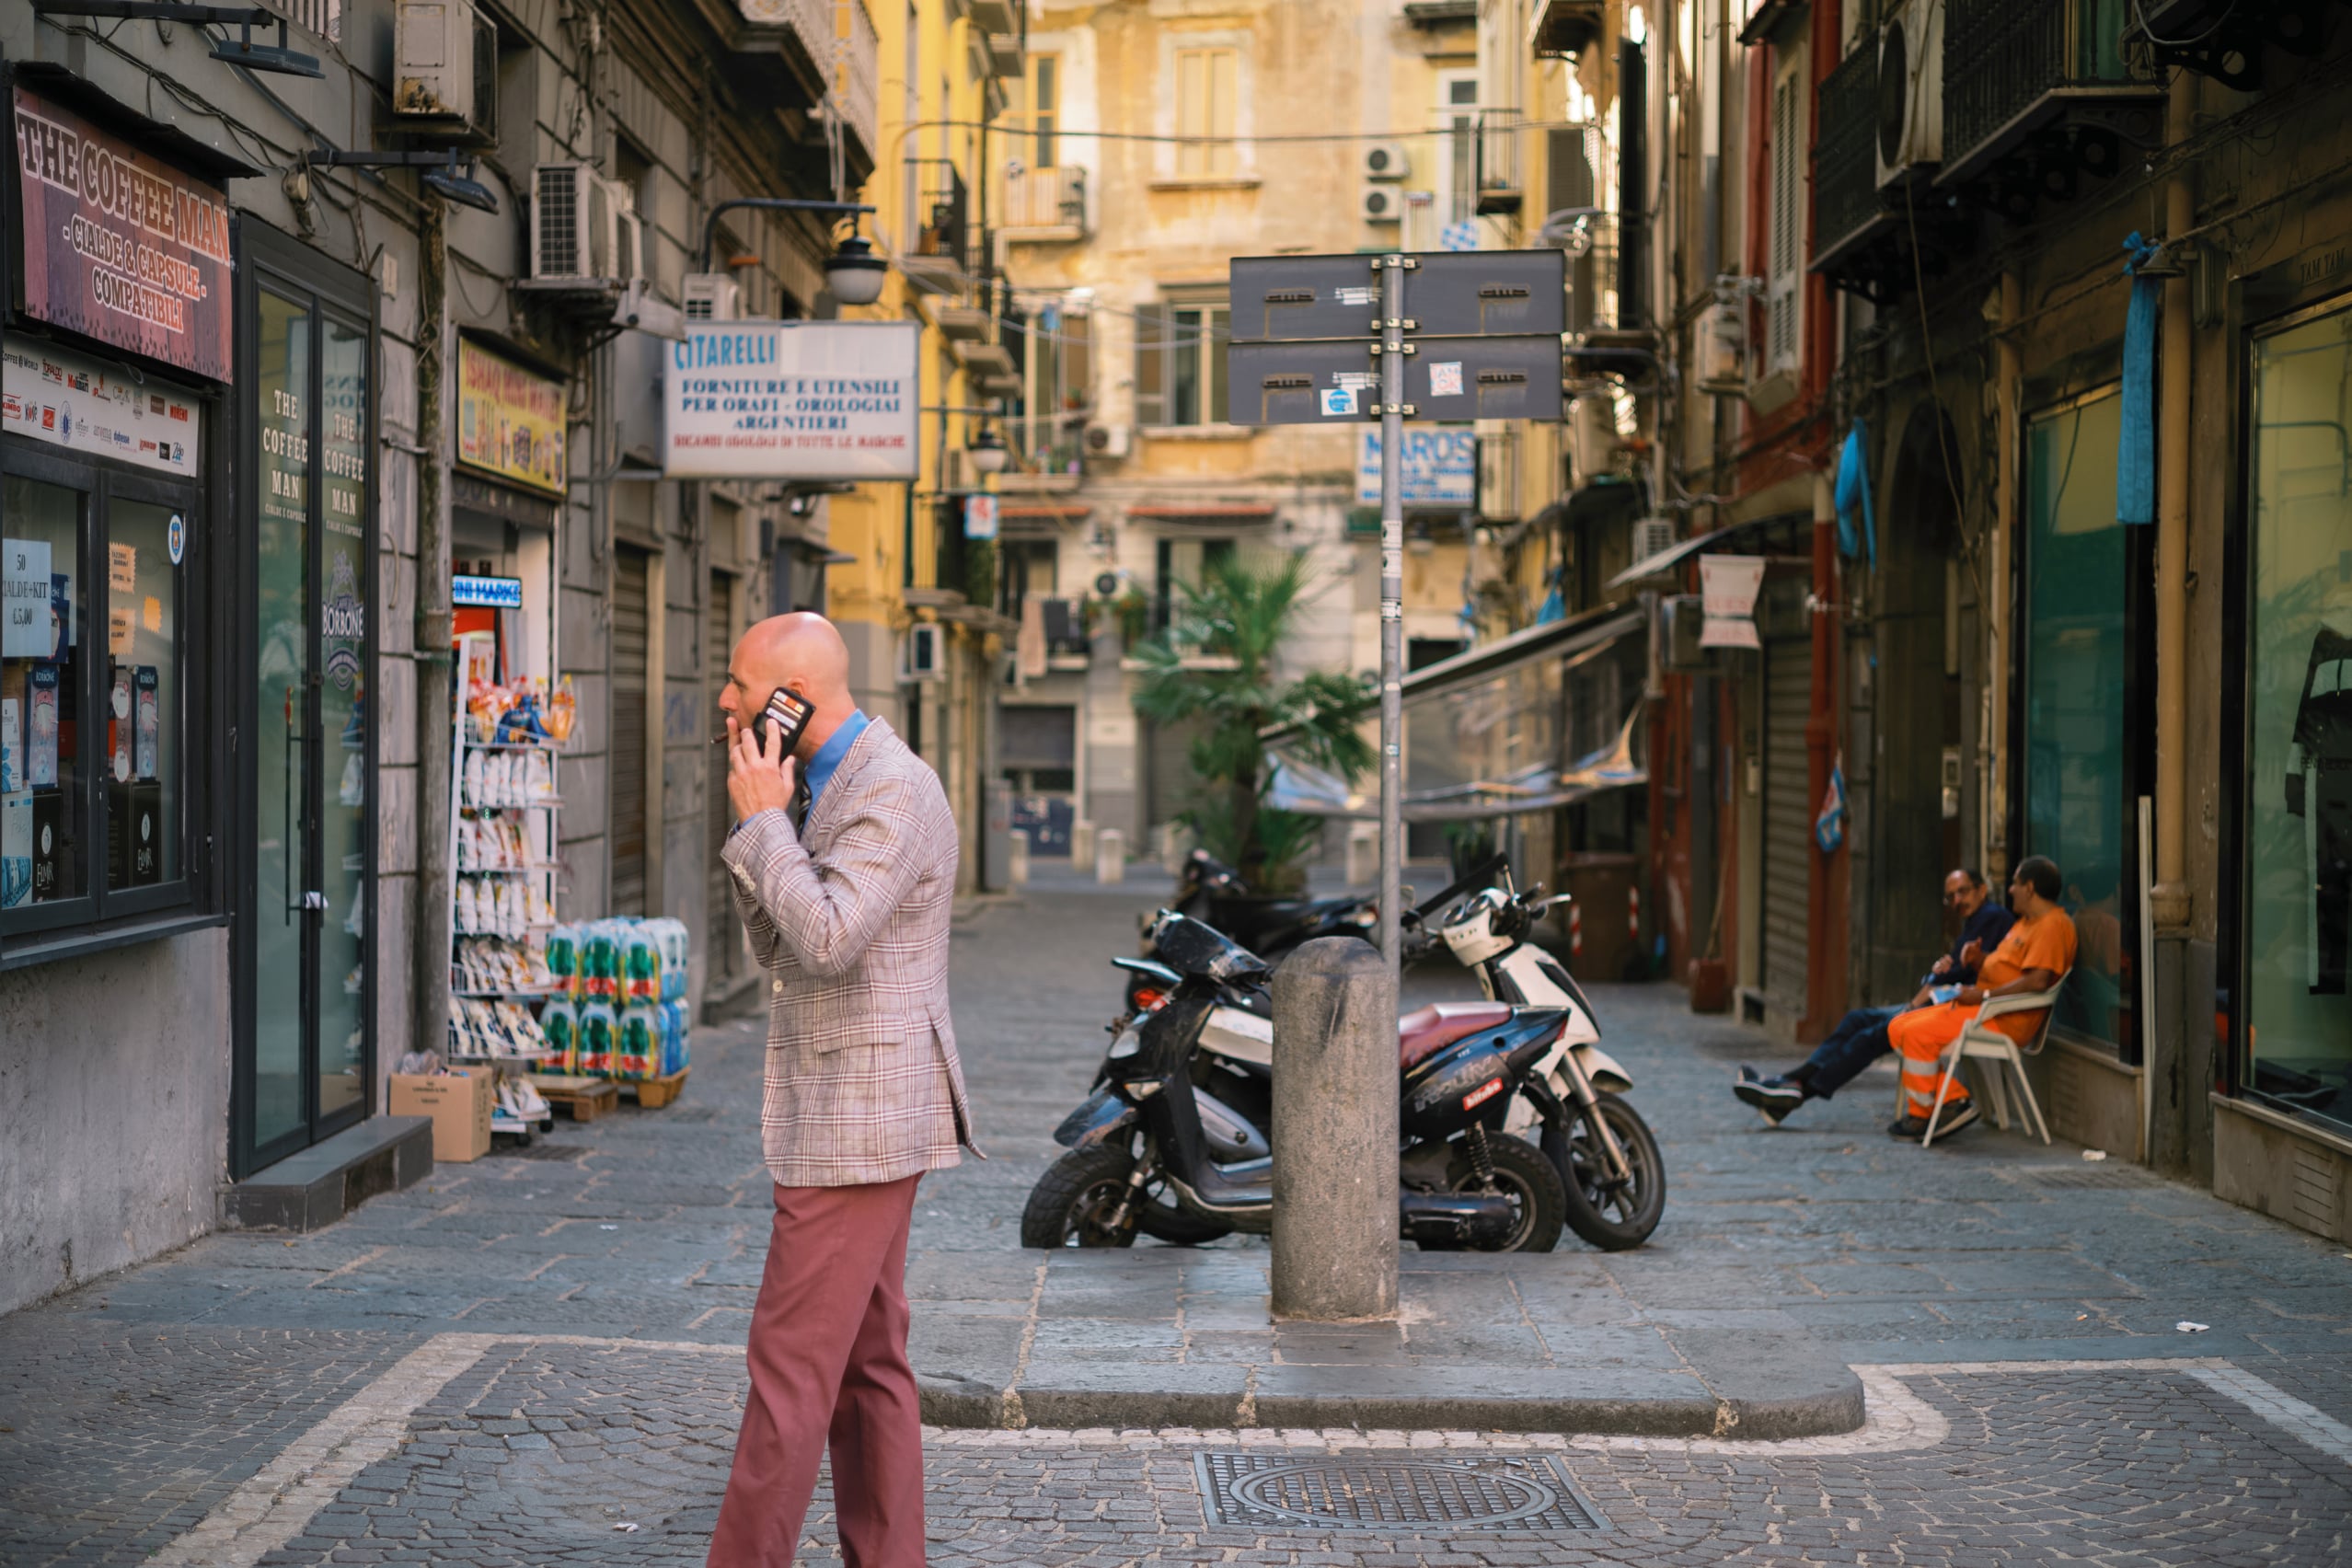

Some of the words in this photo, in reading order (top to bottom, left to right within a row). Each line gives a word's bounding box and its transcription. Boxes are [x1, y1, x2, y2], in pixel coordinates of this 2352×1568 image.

[16, 108, 79, 197] THE
[81, 140, 175, 242] COFFEE
[176, 187, 230, 267] MAN
[72, 213, 123, 271] CIALDE
[124, 239, 136, 276] &
[138, 243, 201, 302] CAPSULE
[92, 266, 184, 334] COMPATIBILI
[674, 334, 776, 370] CITARELLI
[682, 379, 790, 394] FORNITURE
[797, 379, 807, 394] E
[814, 379, 900, 394] UTENSILI
[274, 389, 298, 420] THE
[682, 398, 718, 412] PER
[723, 398, 778, 412] ORAFI
[796, 398, 900, 412] OROLOGIAI
[334, 413, 355, 442] THE
[733, 415, 847, 431] ARGENTIERI
[263, 426, 308, 464] COFFEE
[324, 449, 364, 482] COFFEE
[271, 470, 300, 500] MAN
[332, 488, 357, 516] MAN
[17, 554, 26, 571] 50
[3, 581, 49, 599] IALDE+KIT
[322, 605, 364, 637] BORBONE
